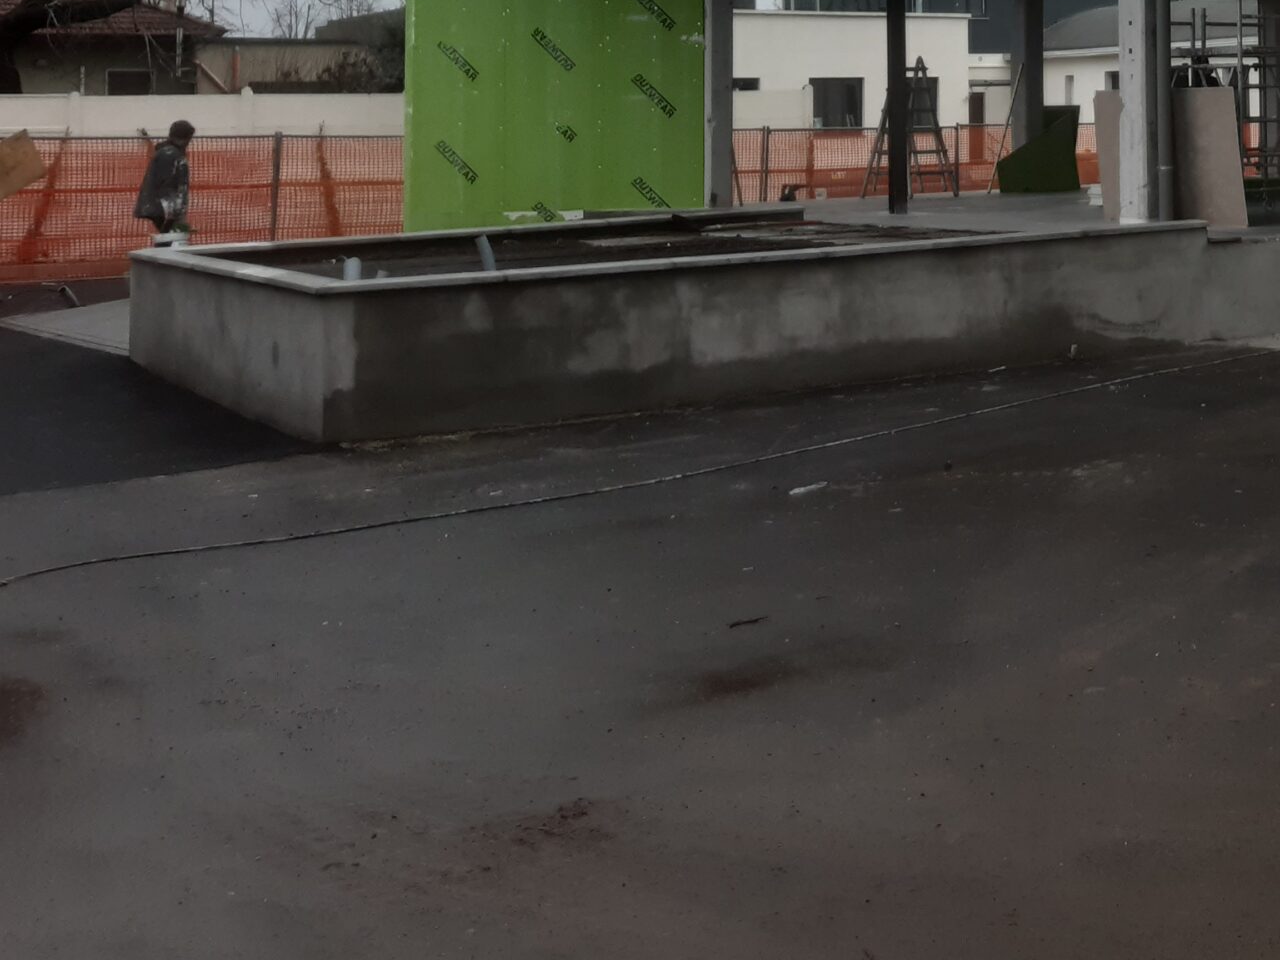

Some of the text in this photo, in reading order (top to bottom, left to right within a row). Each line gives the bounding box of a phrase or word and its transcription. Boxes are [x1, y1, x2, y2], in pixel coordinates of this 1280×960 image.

[531, 27, 576, 72] OUTWEAR
[631, 73, 677, 119] OUTWEAR
[433, 140, 480, 184] OUTWEAR
